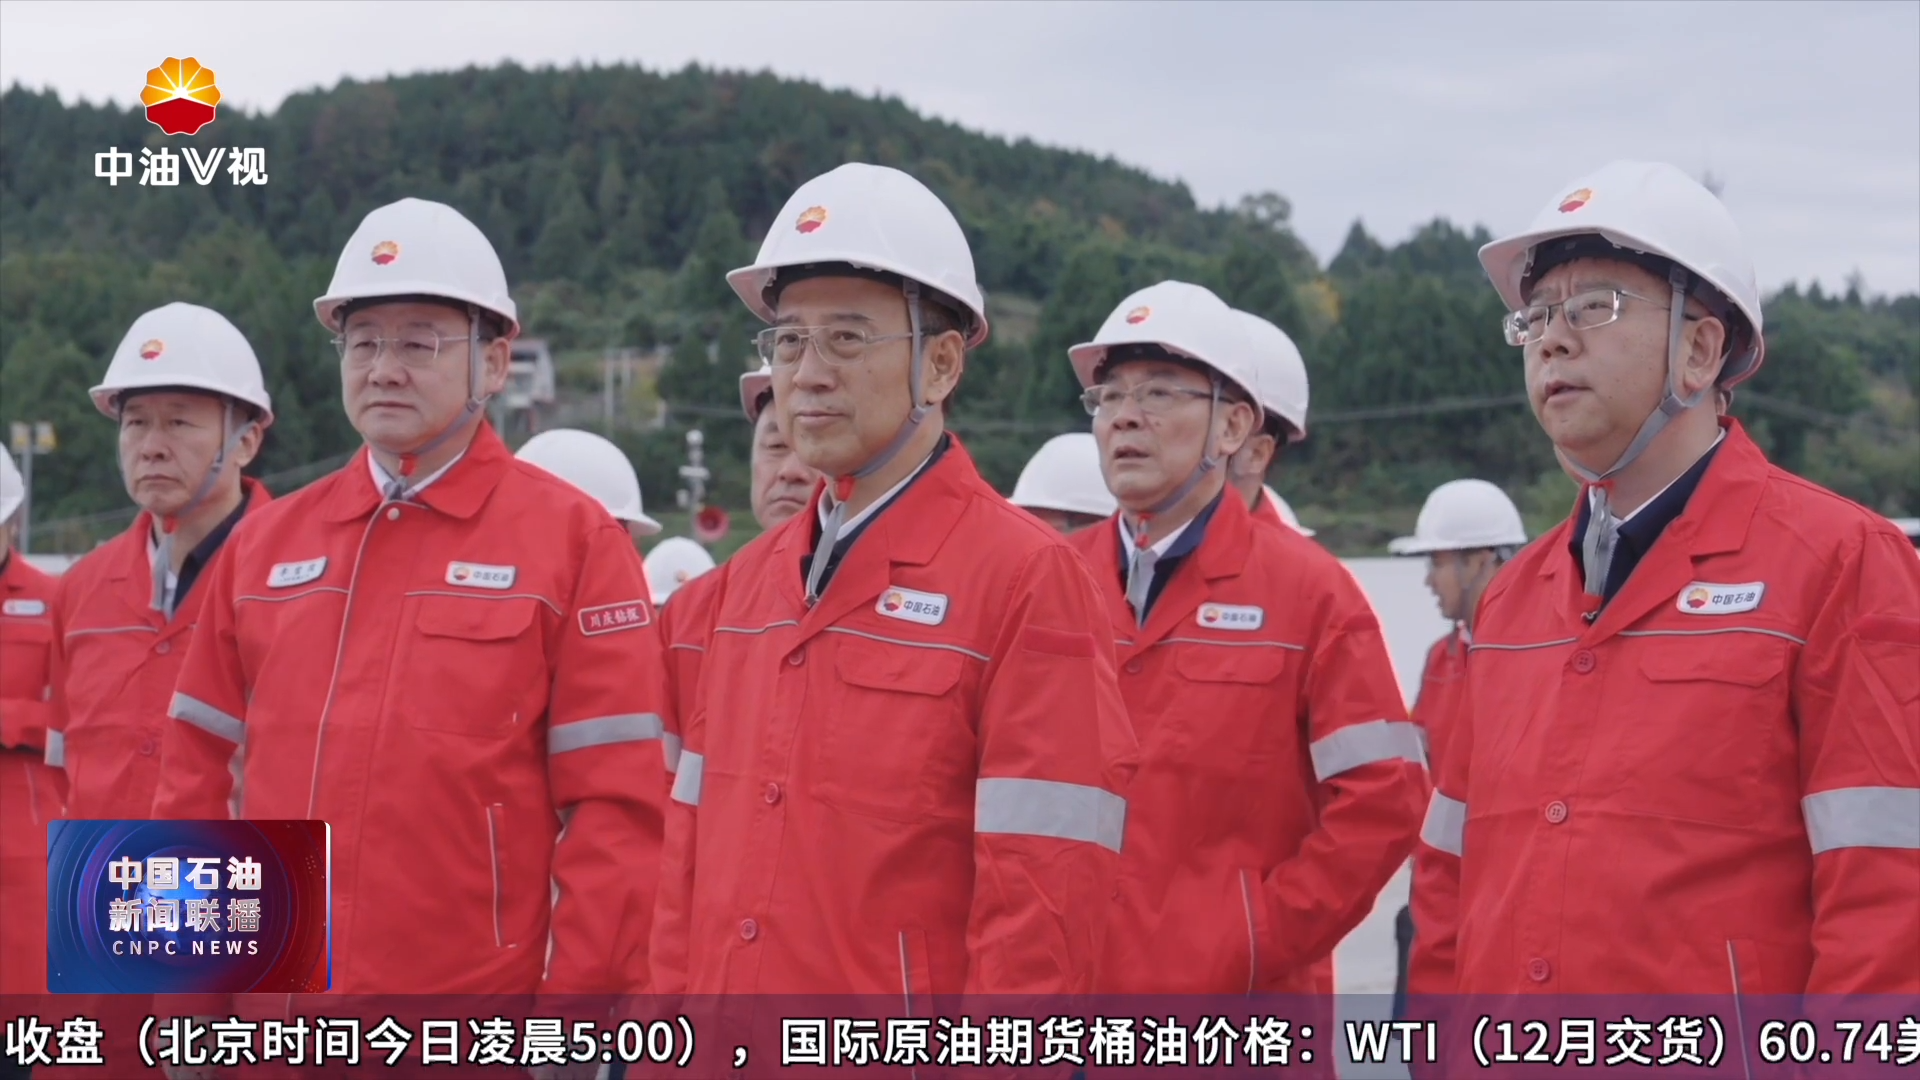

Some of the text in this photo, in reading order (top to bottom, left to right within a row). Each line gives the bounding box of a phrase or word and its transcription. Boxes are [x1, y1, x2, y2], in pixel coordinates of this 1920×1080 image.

[1711, 592, 1756, 605] 中国石油
[903, 600, 941, 616] 中国石油
